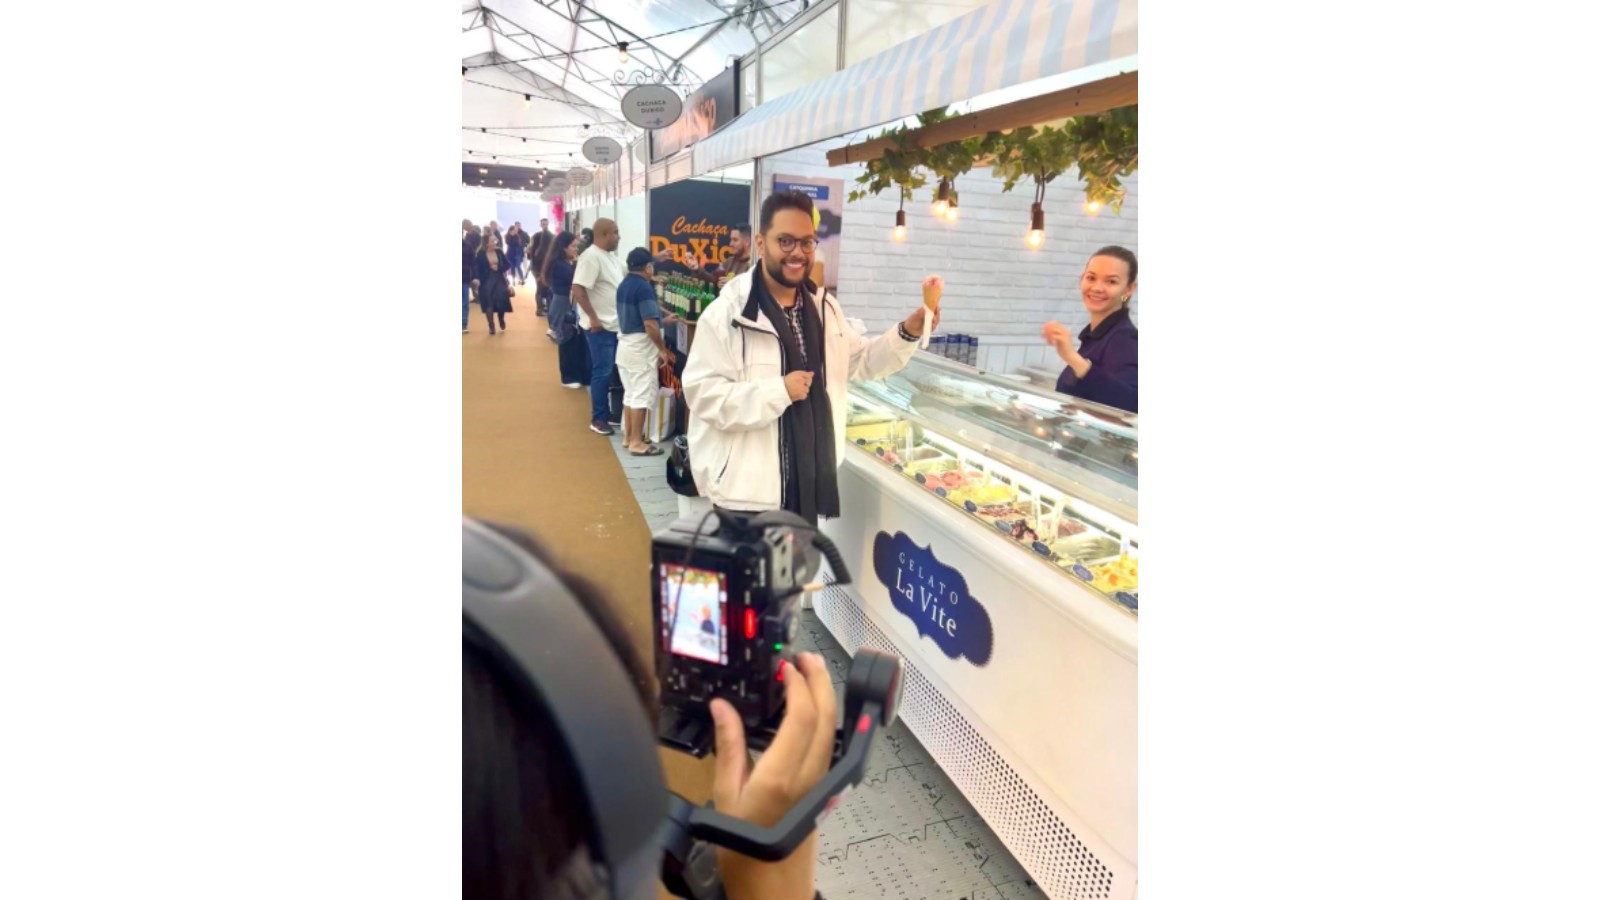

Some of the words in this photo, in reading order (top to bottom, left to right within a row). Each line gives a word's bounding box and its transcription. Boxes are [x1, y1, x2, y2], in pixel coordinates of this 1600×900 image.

[671, 215, 728, 239] Cachaça
[649, 235, 735, 264] DuXic
[899, 552, 958, 605] GELATO
[896, 567, 914, 602] La
[920, 585, 957, 637] Vite
